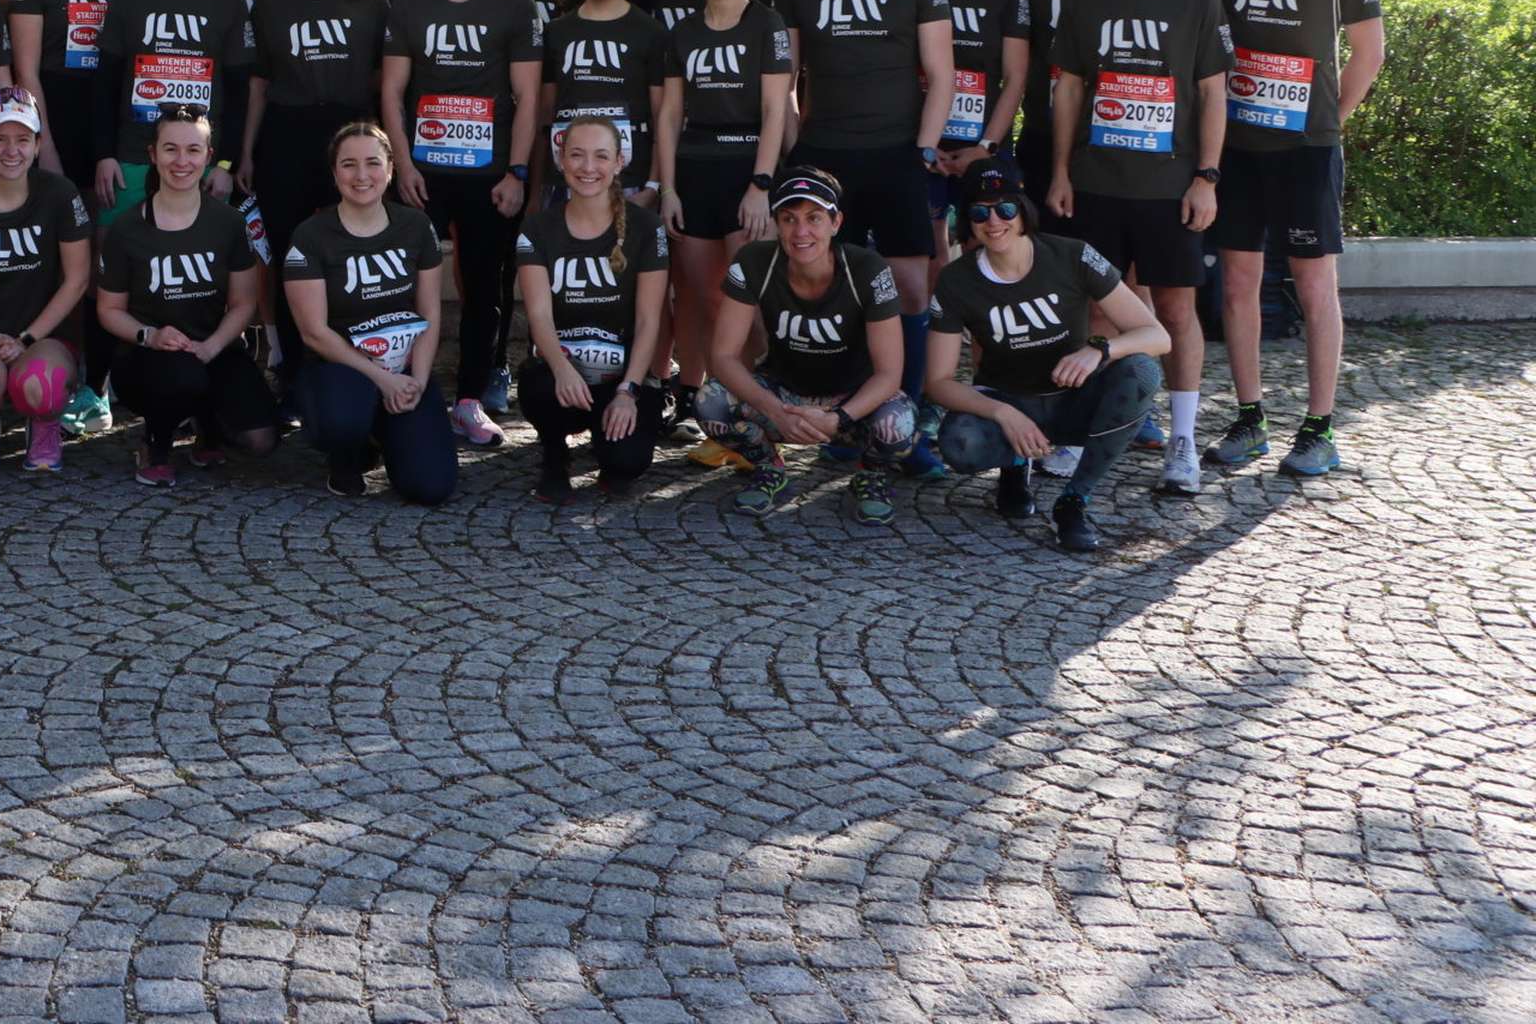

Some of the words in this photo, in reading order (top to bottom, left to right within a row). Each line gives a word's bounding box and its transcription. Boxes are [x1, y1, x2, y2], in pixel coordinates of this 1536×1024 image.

[1250, 52, 1286, 64] WIENER
[1116, 75, 1154, 86] WIENER
[167, 83, 209, 100] 20830
[1257, 81, 1308, 102] 21068
[1126, 104, 1172, 123] 20792
[448, 123, 491, 141] 20834
[1104, 134, 1142, 147] ERSTE
[427, 152, 462, 164] ERSTE
